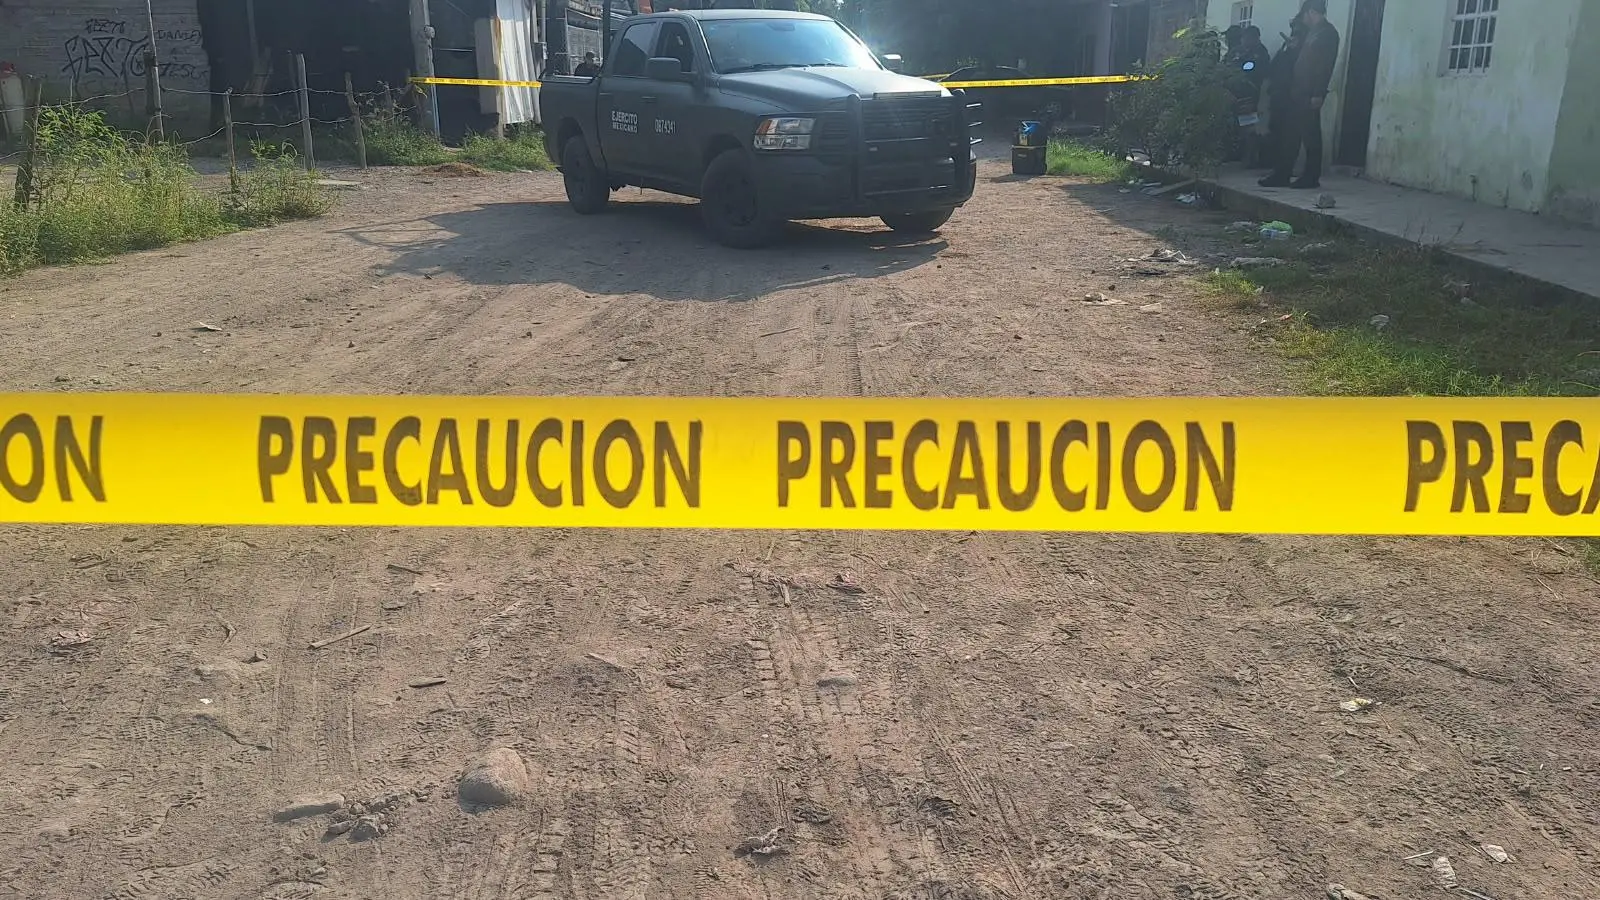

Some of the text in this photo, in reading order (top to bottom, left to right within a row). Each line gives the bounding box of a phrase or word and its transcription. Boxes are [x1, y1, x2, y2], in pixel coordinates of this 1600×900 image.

[611, 110, 638, 125] EJERCITO
[612, 121, 638, 133] MEXICANO
[0, 413, 106, 503] ON
[258, 415, 703, 508] PRECAUCION
[777, 420, 1236, 513] PRECAUCION
